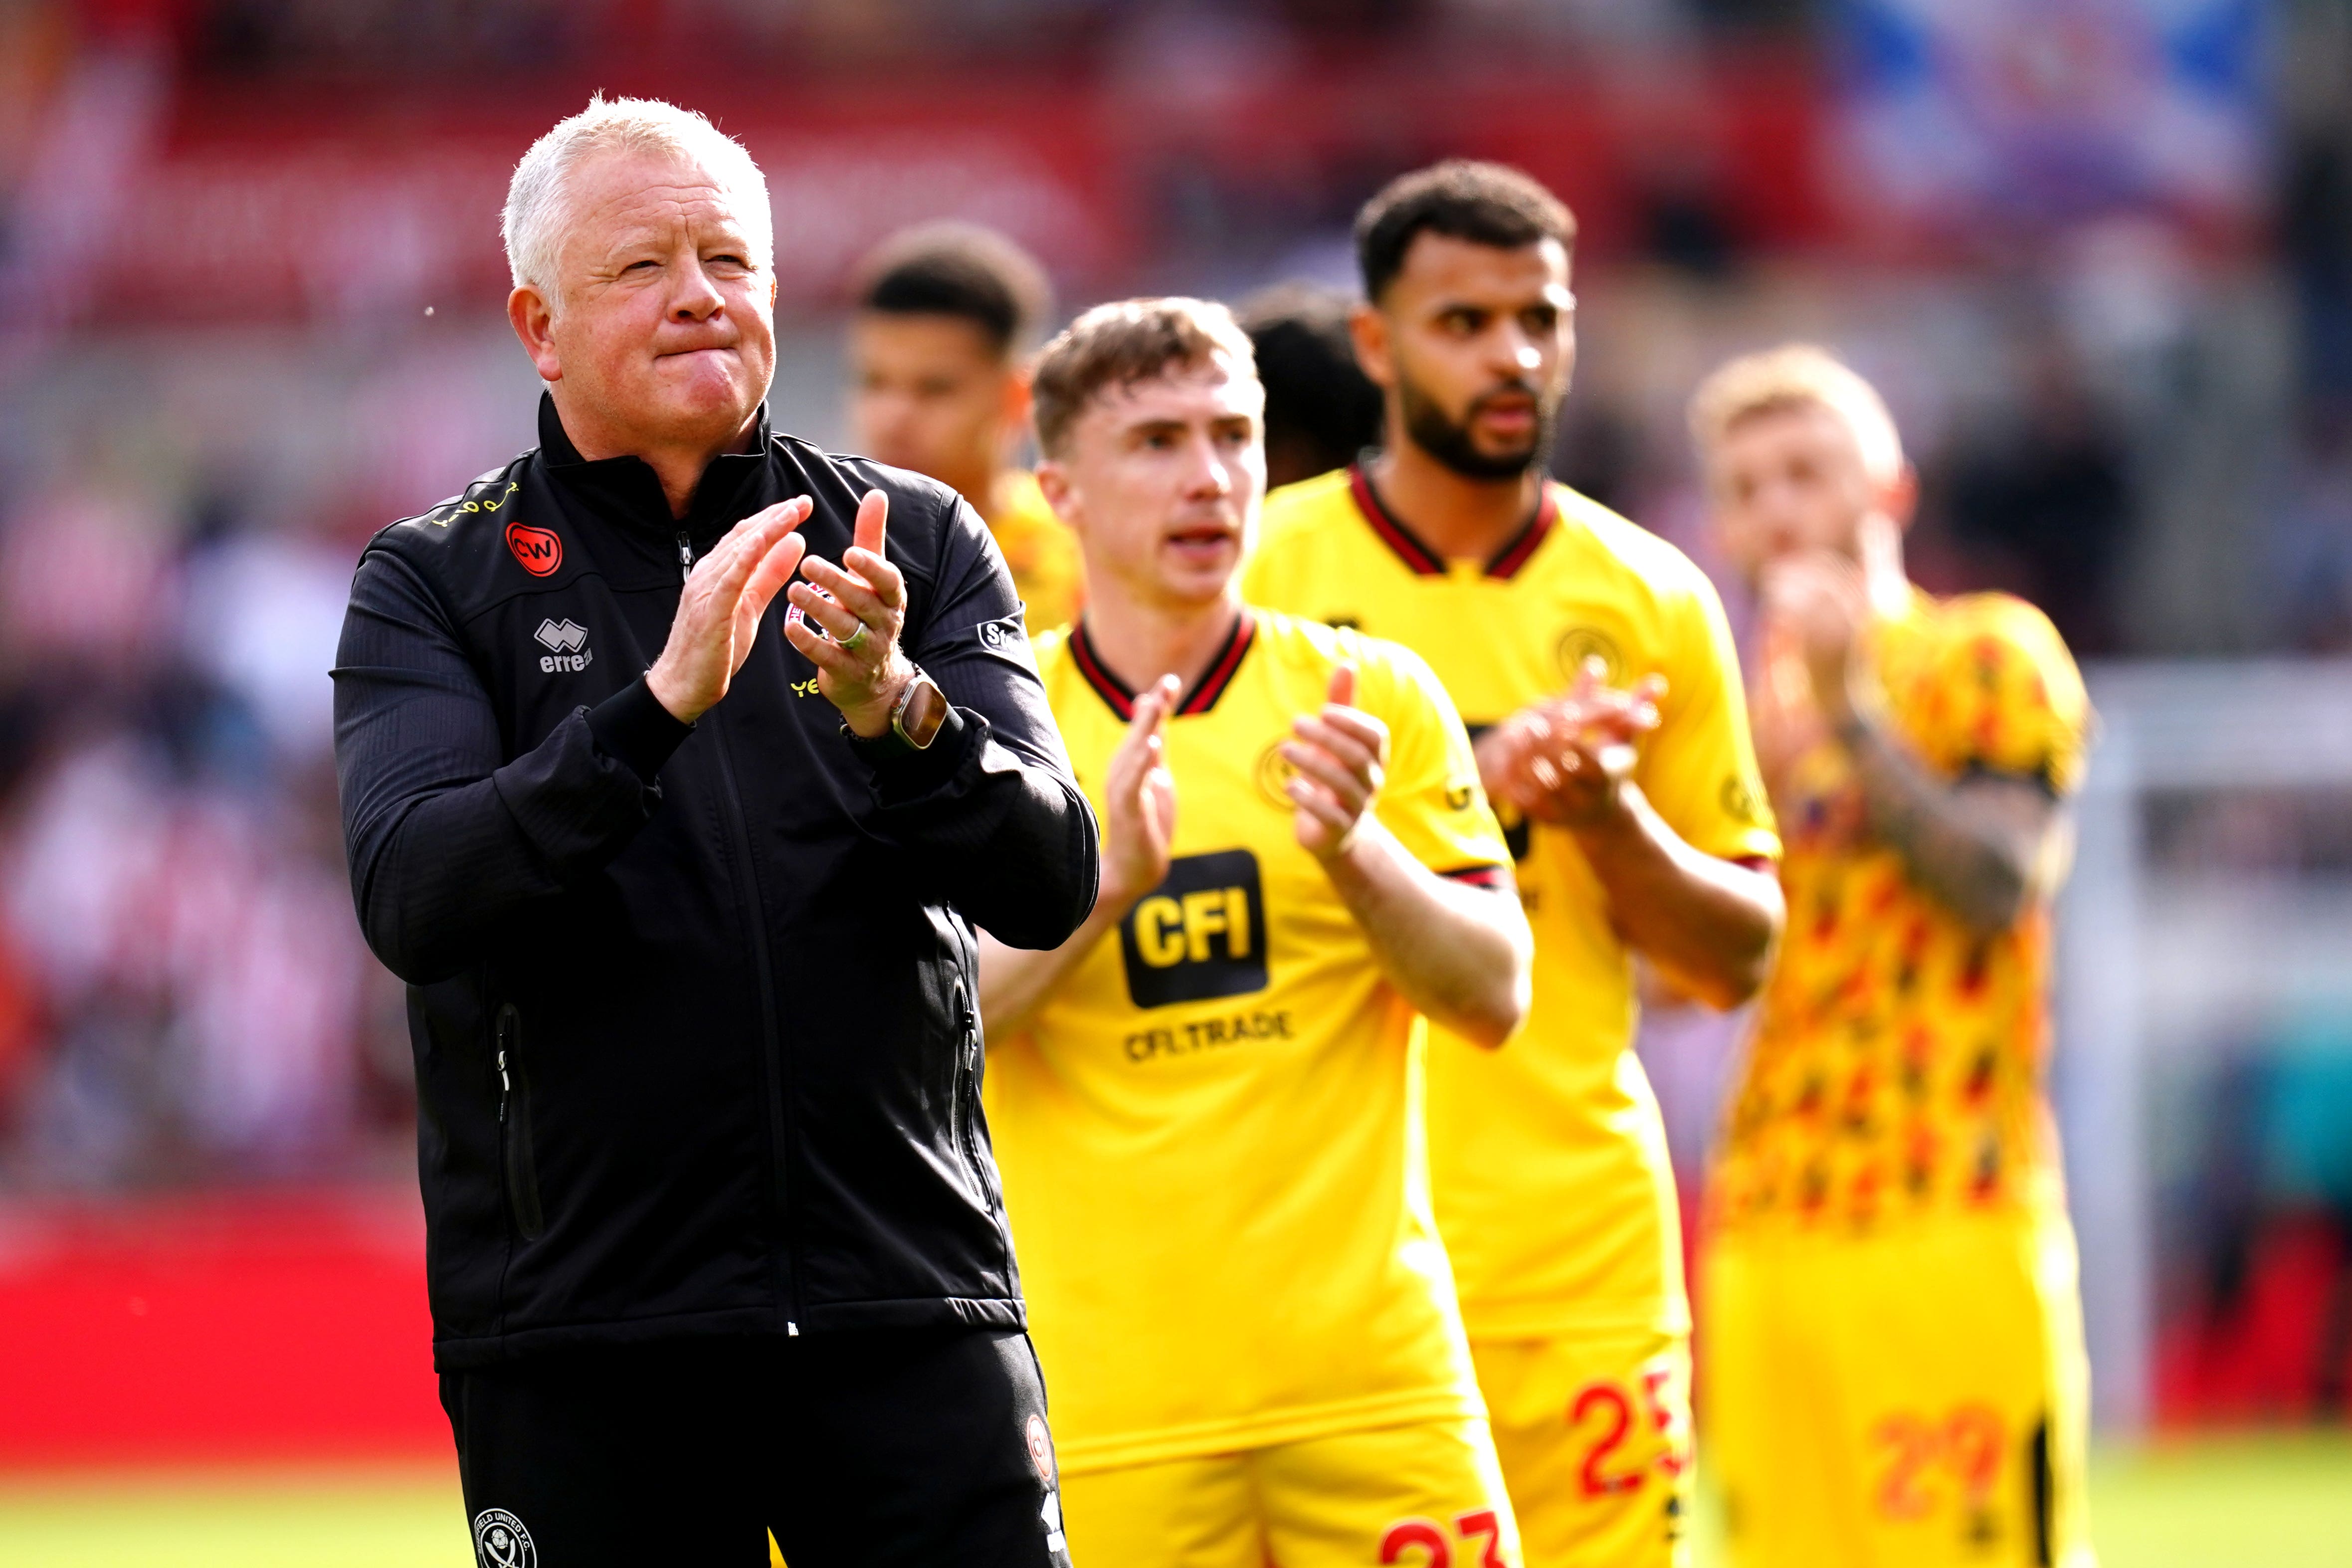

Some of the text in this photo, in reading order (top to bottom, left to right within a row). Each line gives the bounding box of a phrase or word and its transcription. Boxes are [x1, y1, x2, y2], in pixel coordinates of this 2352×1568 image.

[514, 539, 551, 559] CW
[1135, 887, 1249, 968] CFI
[495, 1513, 521, 1532] UNITED
